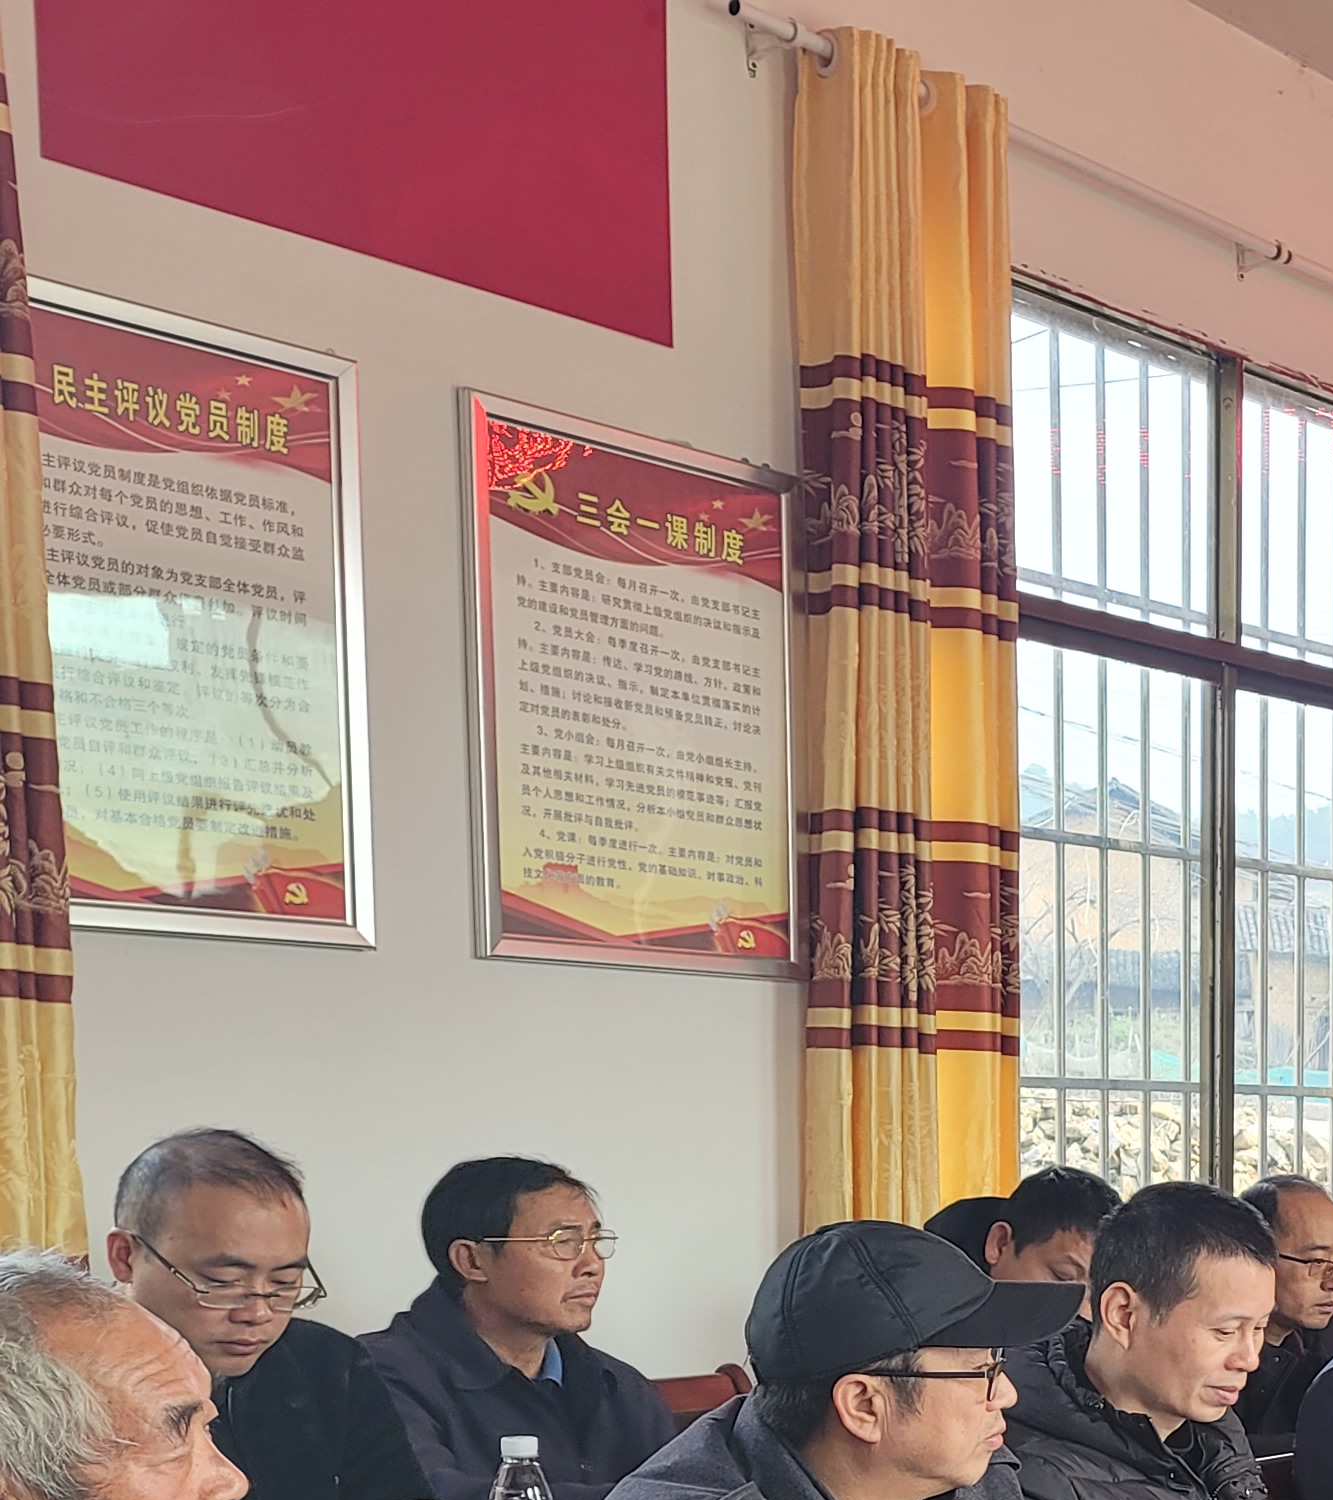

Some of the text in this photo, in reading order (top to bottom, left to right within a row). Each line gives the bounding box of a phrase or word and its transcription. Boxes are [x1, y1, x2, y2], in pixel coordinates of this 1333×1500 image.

[51, 363, 290, 455] 民主评议党员制度
[576, 492, 745, 565] 三会一课制度
